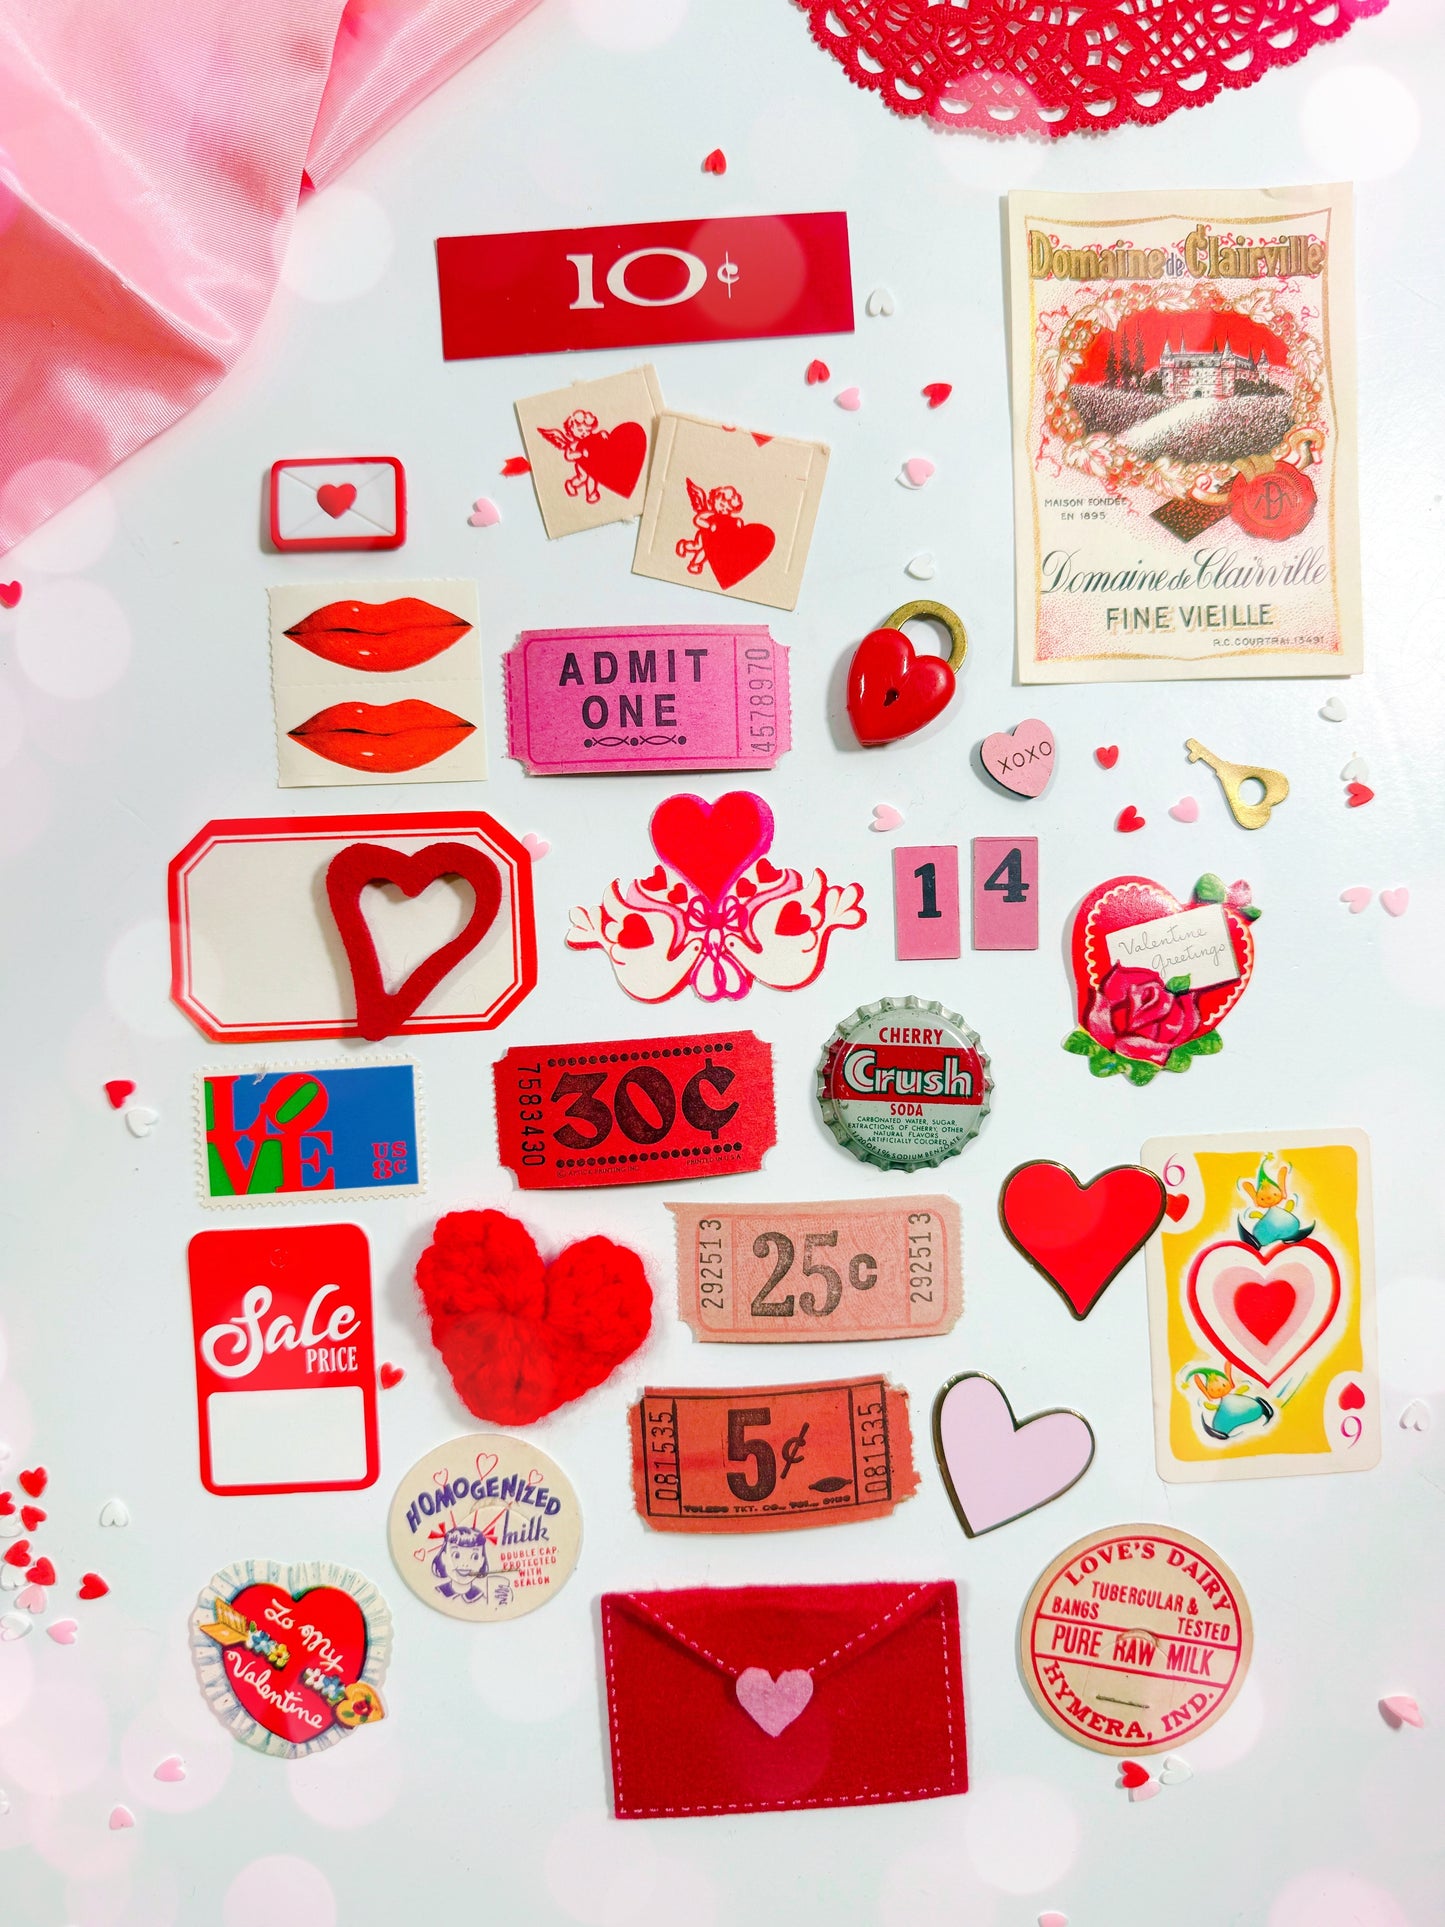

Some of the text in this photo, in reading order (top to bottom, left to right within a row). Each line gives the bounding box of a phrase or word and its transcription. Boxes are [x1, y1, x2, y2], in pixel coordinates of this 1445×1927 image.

[1029, 224, 1327, 281] Domaine de Clairville
[566, 247, 740, 310] 10¢
[1044, 499, 1083, 507] MAISON
[1061, 511, 1106, 520] EN 1895
[1041, 545, 1328, 594] Domaine de Clairville
[1106, 604, 1275, 632] FINE VIEILLE
[559, 648, 708, 686] ADMIT
[582, 694, 677, 729] ONE
[744, 648, 775, 752] 4578970
[997, 741, 1052, 774] XOXO
[914, 863, 942, 918] 1
[984, 848, 1029, 902] 4
[1118, 925, 1207, 955] Valentine
[879, 1027, 944, 1045] CHERRY
[843, 1049, 973, 1097] Crush
[517, 1063, 546, 1166] 7583430
[550, 1057, 740, 1150] 30¢
[848, 1122, 894, 1130] EXTRACTIONS
[857, 1116, 902, 1124] CARBONATED
[890, 1103, 924, 1116] SODA
[372, 1141, 407, 1159] US
[852, 1130, 961, 1160] 1/20 OF 1% SODIUM BENZOATE
[1163, 1152, 1185, 1187] 6
[699, 1219, 724, 1309] 292513
[908, 1212, 933, 1303] 292513
[201, 1284, 361, 1378] Sale
[306, 1347, 358, 1374] PRICE
[649, 1411, 680, 1501] 081535
[726, 1407, 809, 1501] 5¢
[858, 1402, 889, 1493] 081535
[406, 1474, 561, 1533] HOMOGENIZED
[734, 1505, 758, 1513] TKT.
[501, 1509, 550, 1546] milk
[500, 1548, 536, 1561] DOUBLE
[503, 1556, 556, 1571] PROTECTED
[519, 1568, 542, 1577] WITH
[1064, 1542, 1231, 1611] LOVE'S DAIRY
[1052, 1596, 1230, 1642] BANGS TESTED
[1092, 1581, 1199, 1615] TUBERCULAR &
[264, 1598, 343, 1672] To My
[1051, 1624, 1215, 1677] PURE RAW MILK
[227, 1650, 323, 1729] Valentine
[1043, 1661, 1215, 1741] HYMERA, IND.
